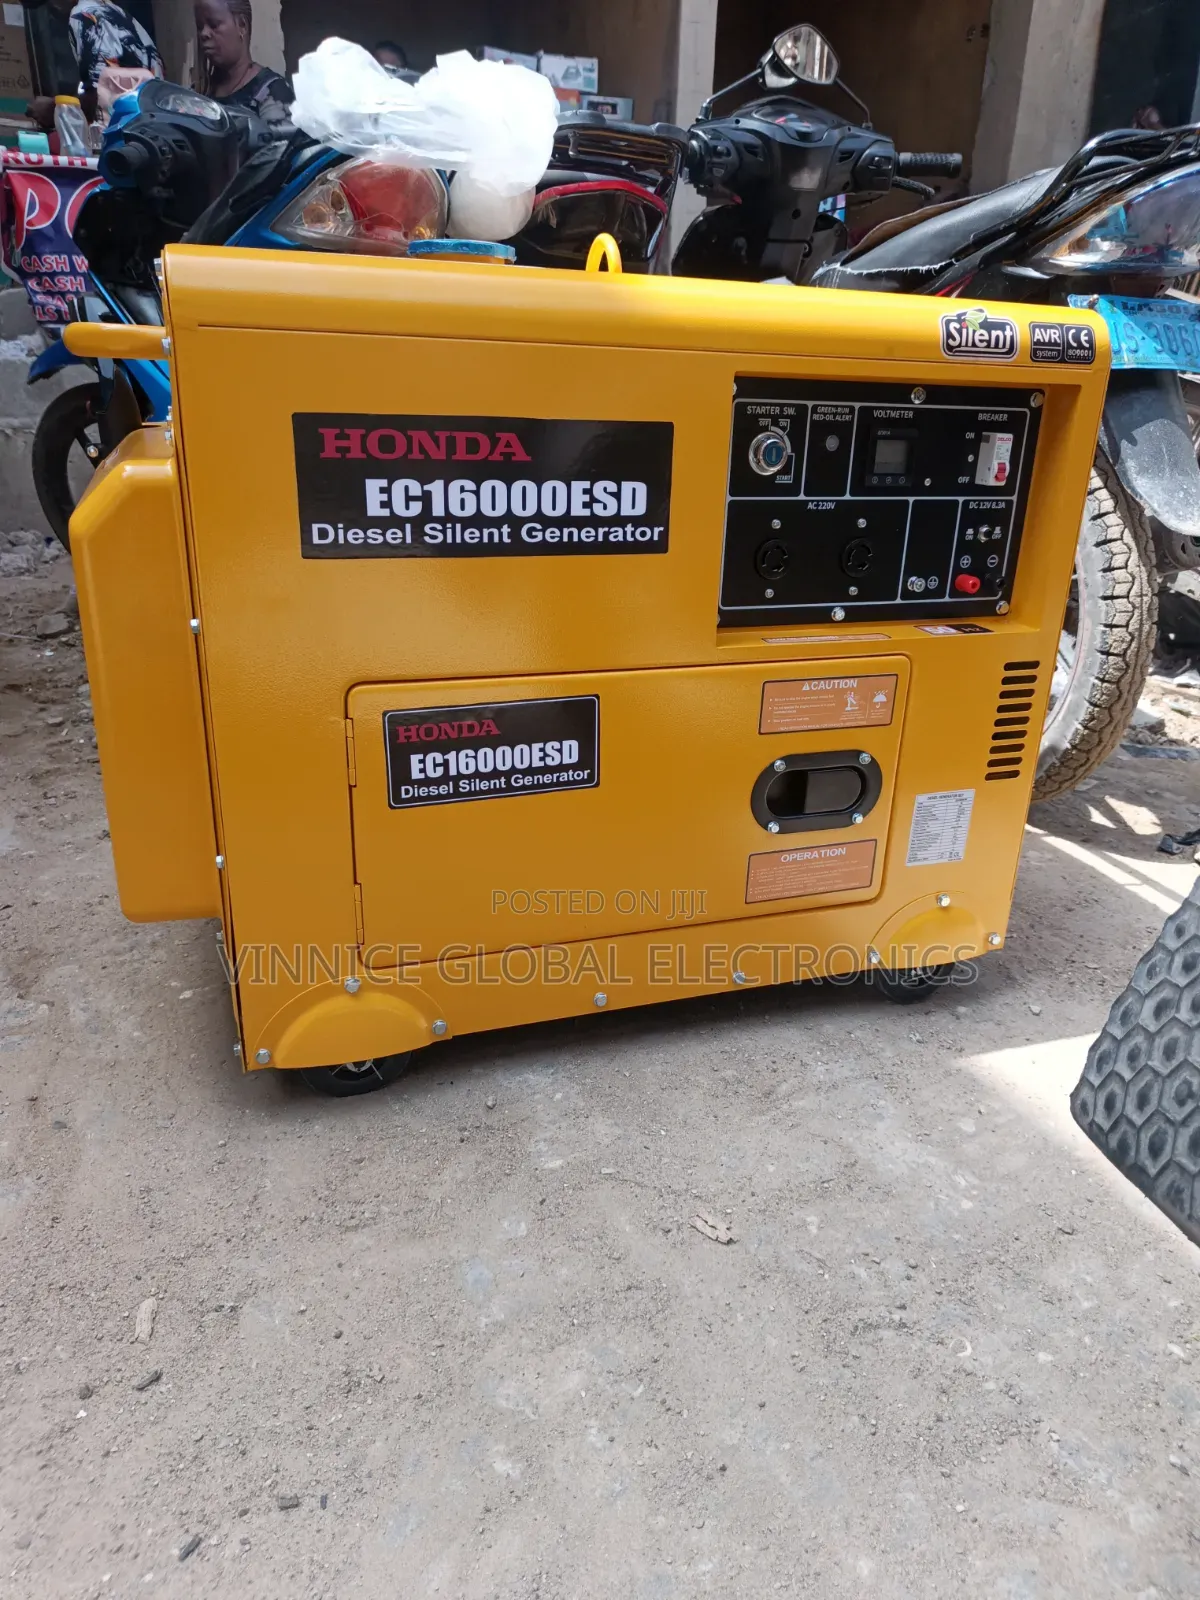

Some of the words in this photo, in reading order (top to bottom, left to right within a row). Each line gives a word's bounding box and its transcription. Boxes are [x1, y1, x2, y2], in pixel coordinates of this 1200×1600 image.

[21, 254, 70, 272] CASH
[28, 275, 86, 292] CASH
[948, 321, 1014, 349] Silent
[1034, 328, 1061, 344] AVR
[1068, 328, 1090, 347] CE
[1036, 349, 1058, 358] system
[747, 405, 780, 415] STARTER
[783, 406, 797, 415] SW.
[817, 406, 850, 414] GREEN-RUN
[873, 409, 914, 419] VOLTMETER
[835, 414, 853, 422] ALERT
[977, 413, 1008, 422] BREAKER
[965, 432, 975, 440] ON
[318, 427, 532, 462] HONDA
[958, 476, 970, 484] OFF
[364, 478, 647, 518] EC16000ESD
[807, 501, 817, 510] AC
[818, 501, 836, 510] 220V
[969, 501, 978, 509] DC
[979, 501, 991, 509] 12V
[311, 523, 411, 545] Diesel
[423, 522, 511, 544] Silent
[520, 522, 664, 543] Generator
[811, 679, 858, 691] CAUTION
[396, 718, 501, 744] HONDA
[410, 739, 579, 780] EC16000ESD
[401, 781, 453, 799] Diesel
[458, 776, 506, 793] Silent
[510, 768, 591, 787] Generator
[780, 847, 847, 862] OPERATION
